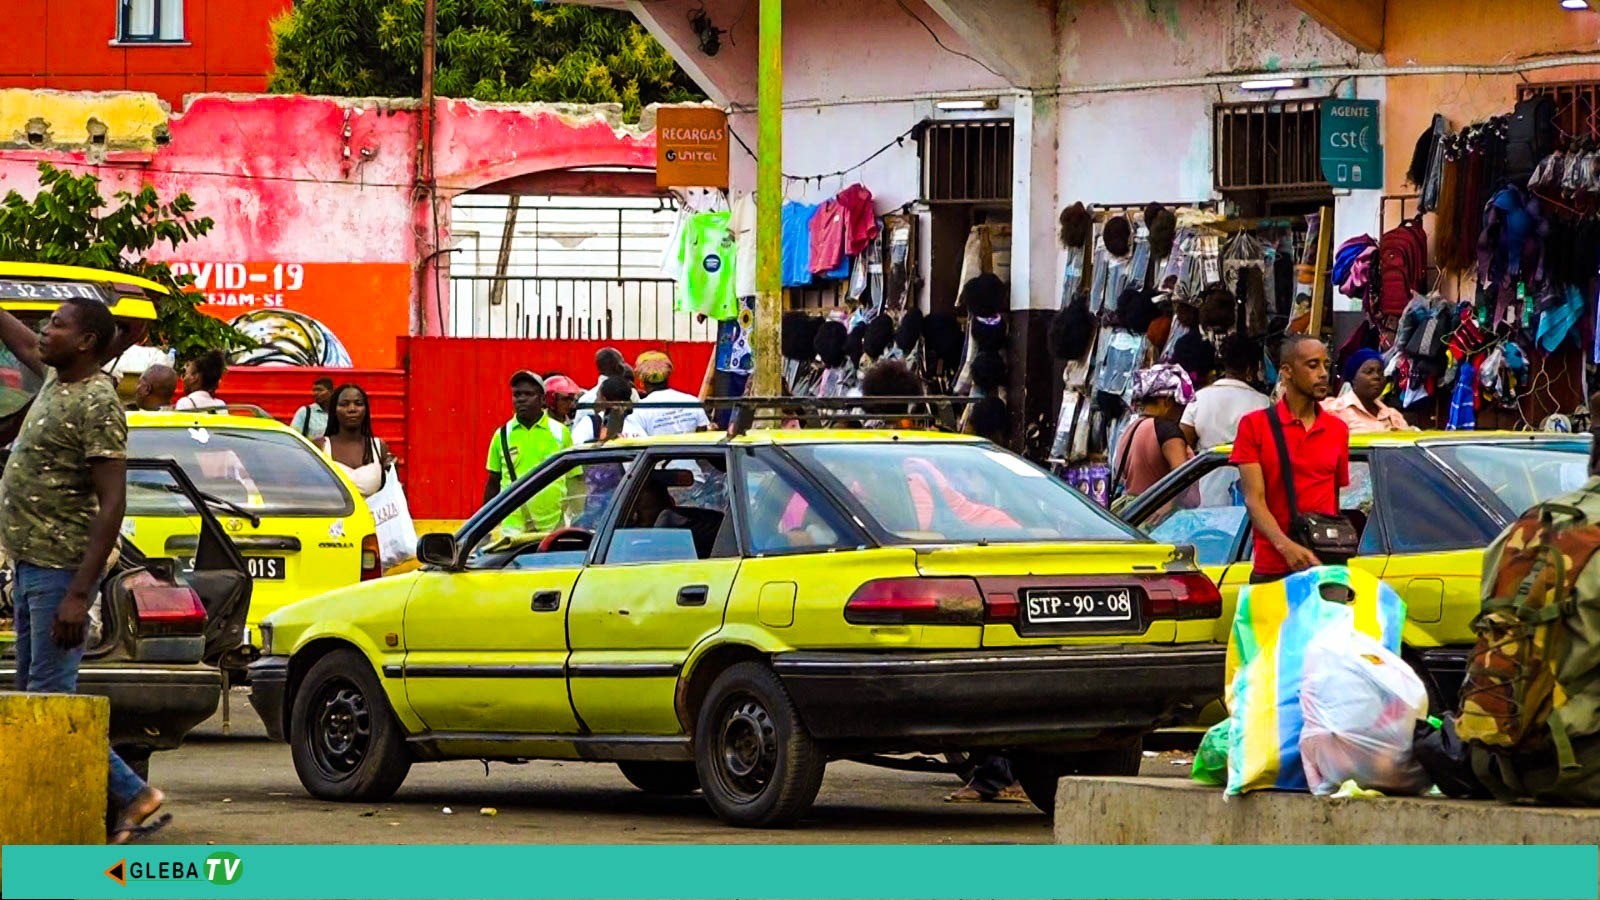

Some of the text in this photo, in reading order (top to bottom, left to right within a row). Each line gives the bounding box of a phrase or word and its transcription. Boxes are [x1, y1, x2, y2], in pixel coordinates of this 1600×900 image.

[1330, 106, 1370, 117] AGENTE
[662, 127, 724, 141] RECARGAS
[1330, 130, 1357, 149] cst
[169, 262, 304, 291] OVID-19
[203, 292, 284, 307] EJAM-SE
